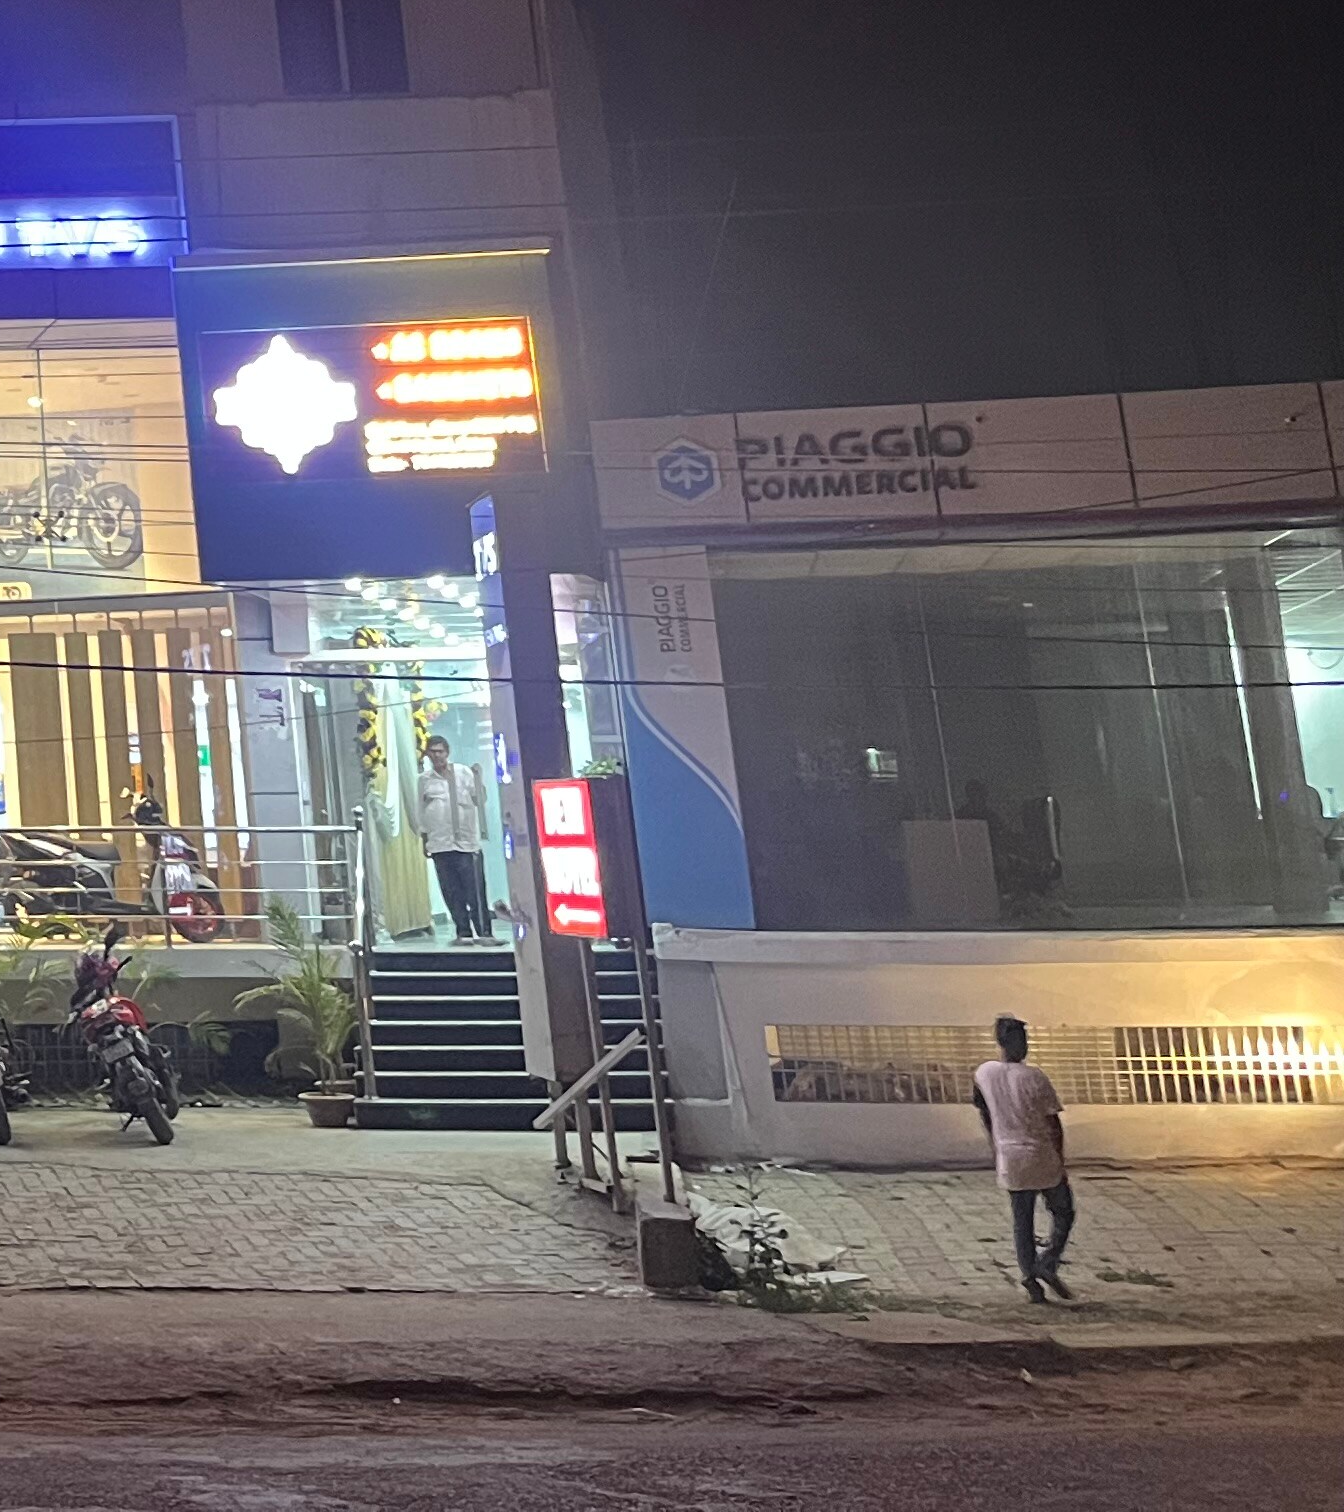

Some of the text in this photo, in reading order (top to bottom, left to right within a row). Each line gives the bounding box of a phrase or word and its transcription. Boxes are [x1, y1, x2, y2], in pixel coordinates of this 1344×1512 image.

[15, 212, 149, 258] TVS
[735, 423, 975, 470] PIAGGIO
[742, 464, 977, 503] COMMERCIAL
[652, 585, 676, 653] PIAGGIO
[675, 584, 692, 653] COMMERCIAL
